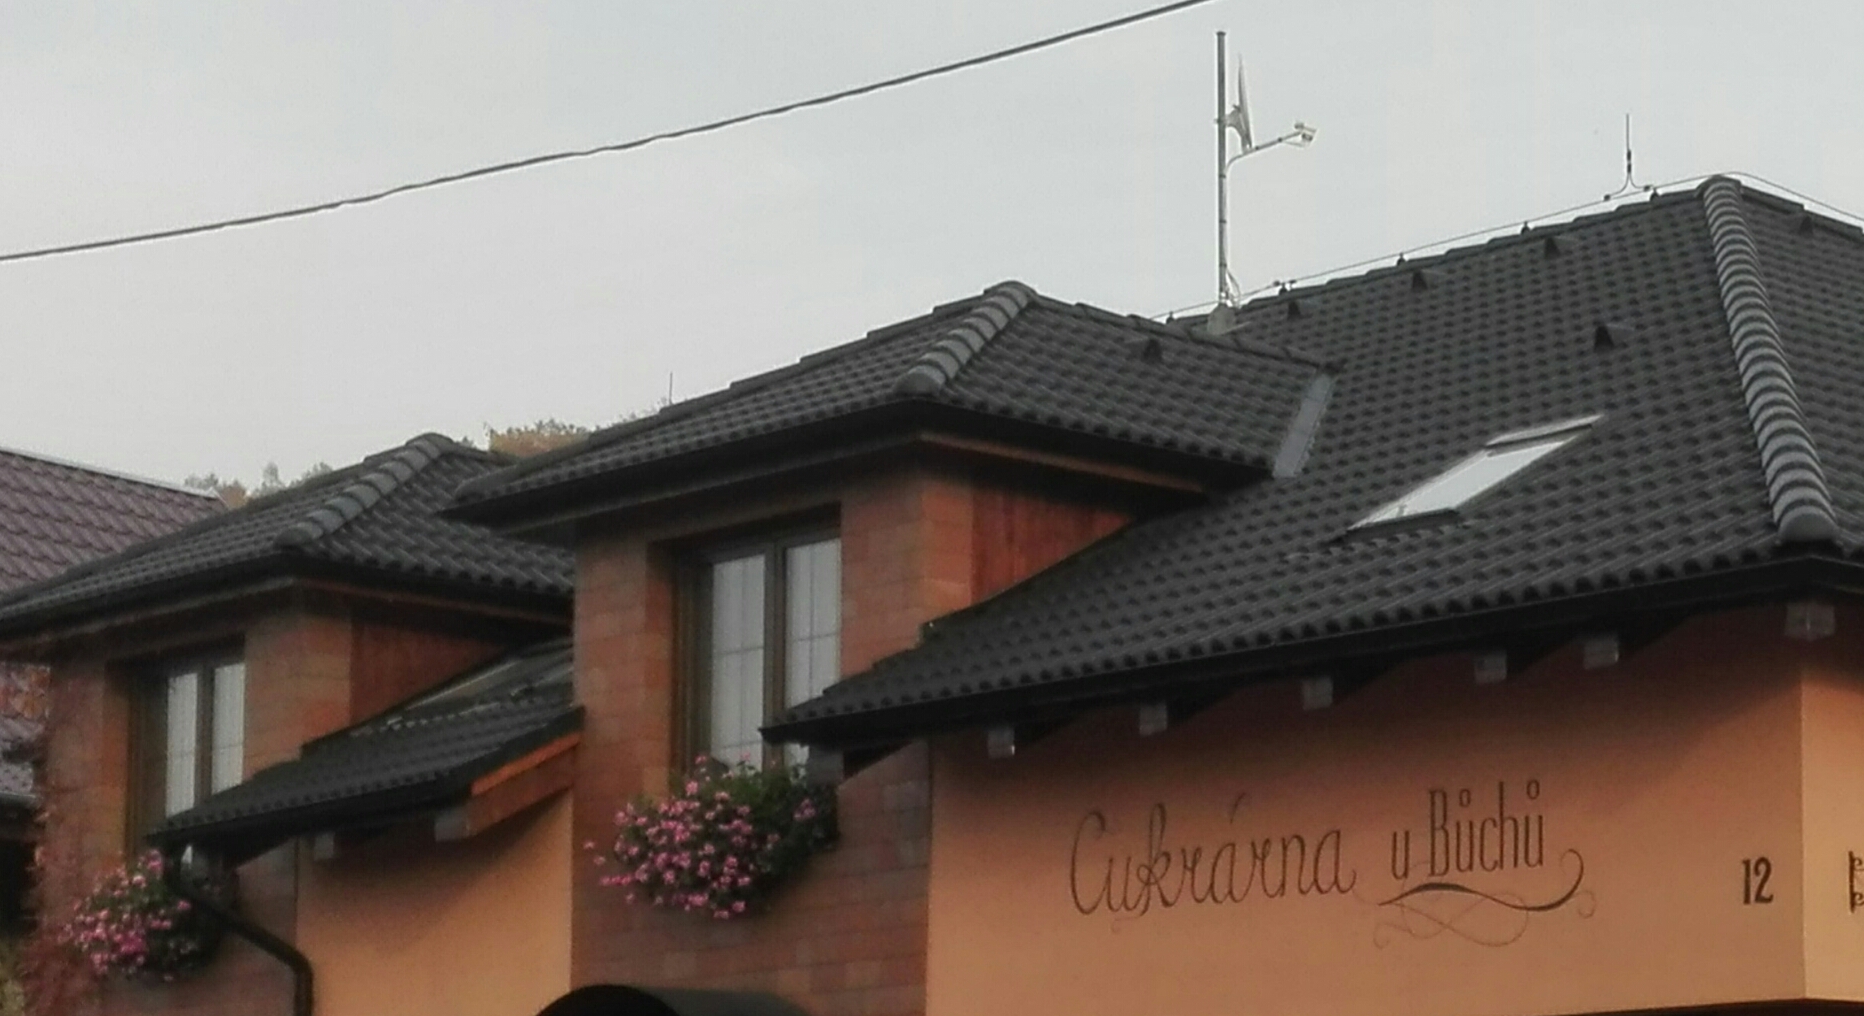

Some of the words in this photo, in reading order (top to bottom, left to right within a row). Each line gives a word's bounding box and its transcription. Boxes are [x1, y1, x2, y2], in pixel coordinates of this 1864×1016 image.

[1069, 792, 1356, 916] Cukrárna
[1391, 829, 1410, 880] u
[1428, 779, 1544, 878] Bůchů
[1742, 856, 1774, 905] 12
